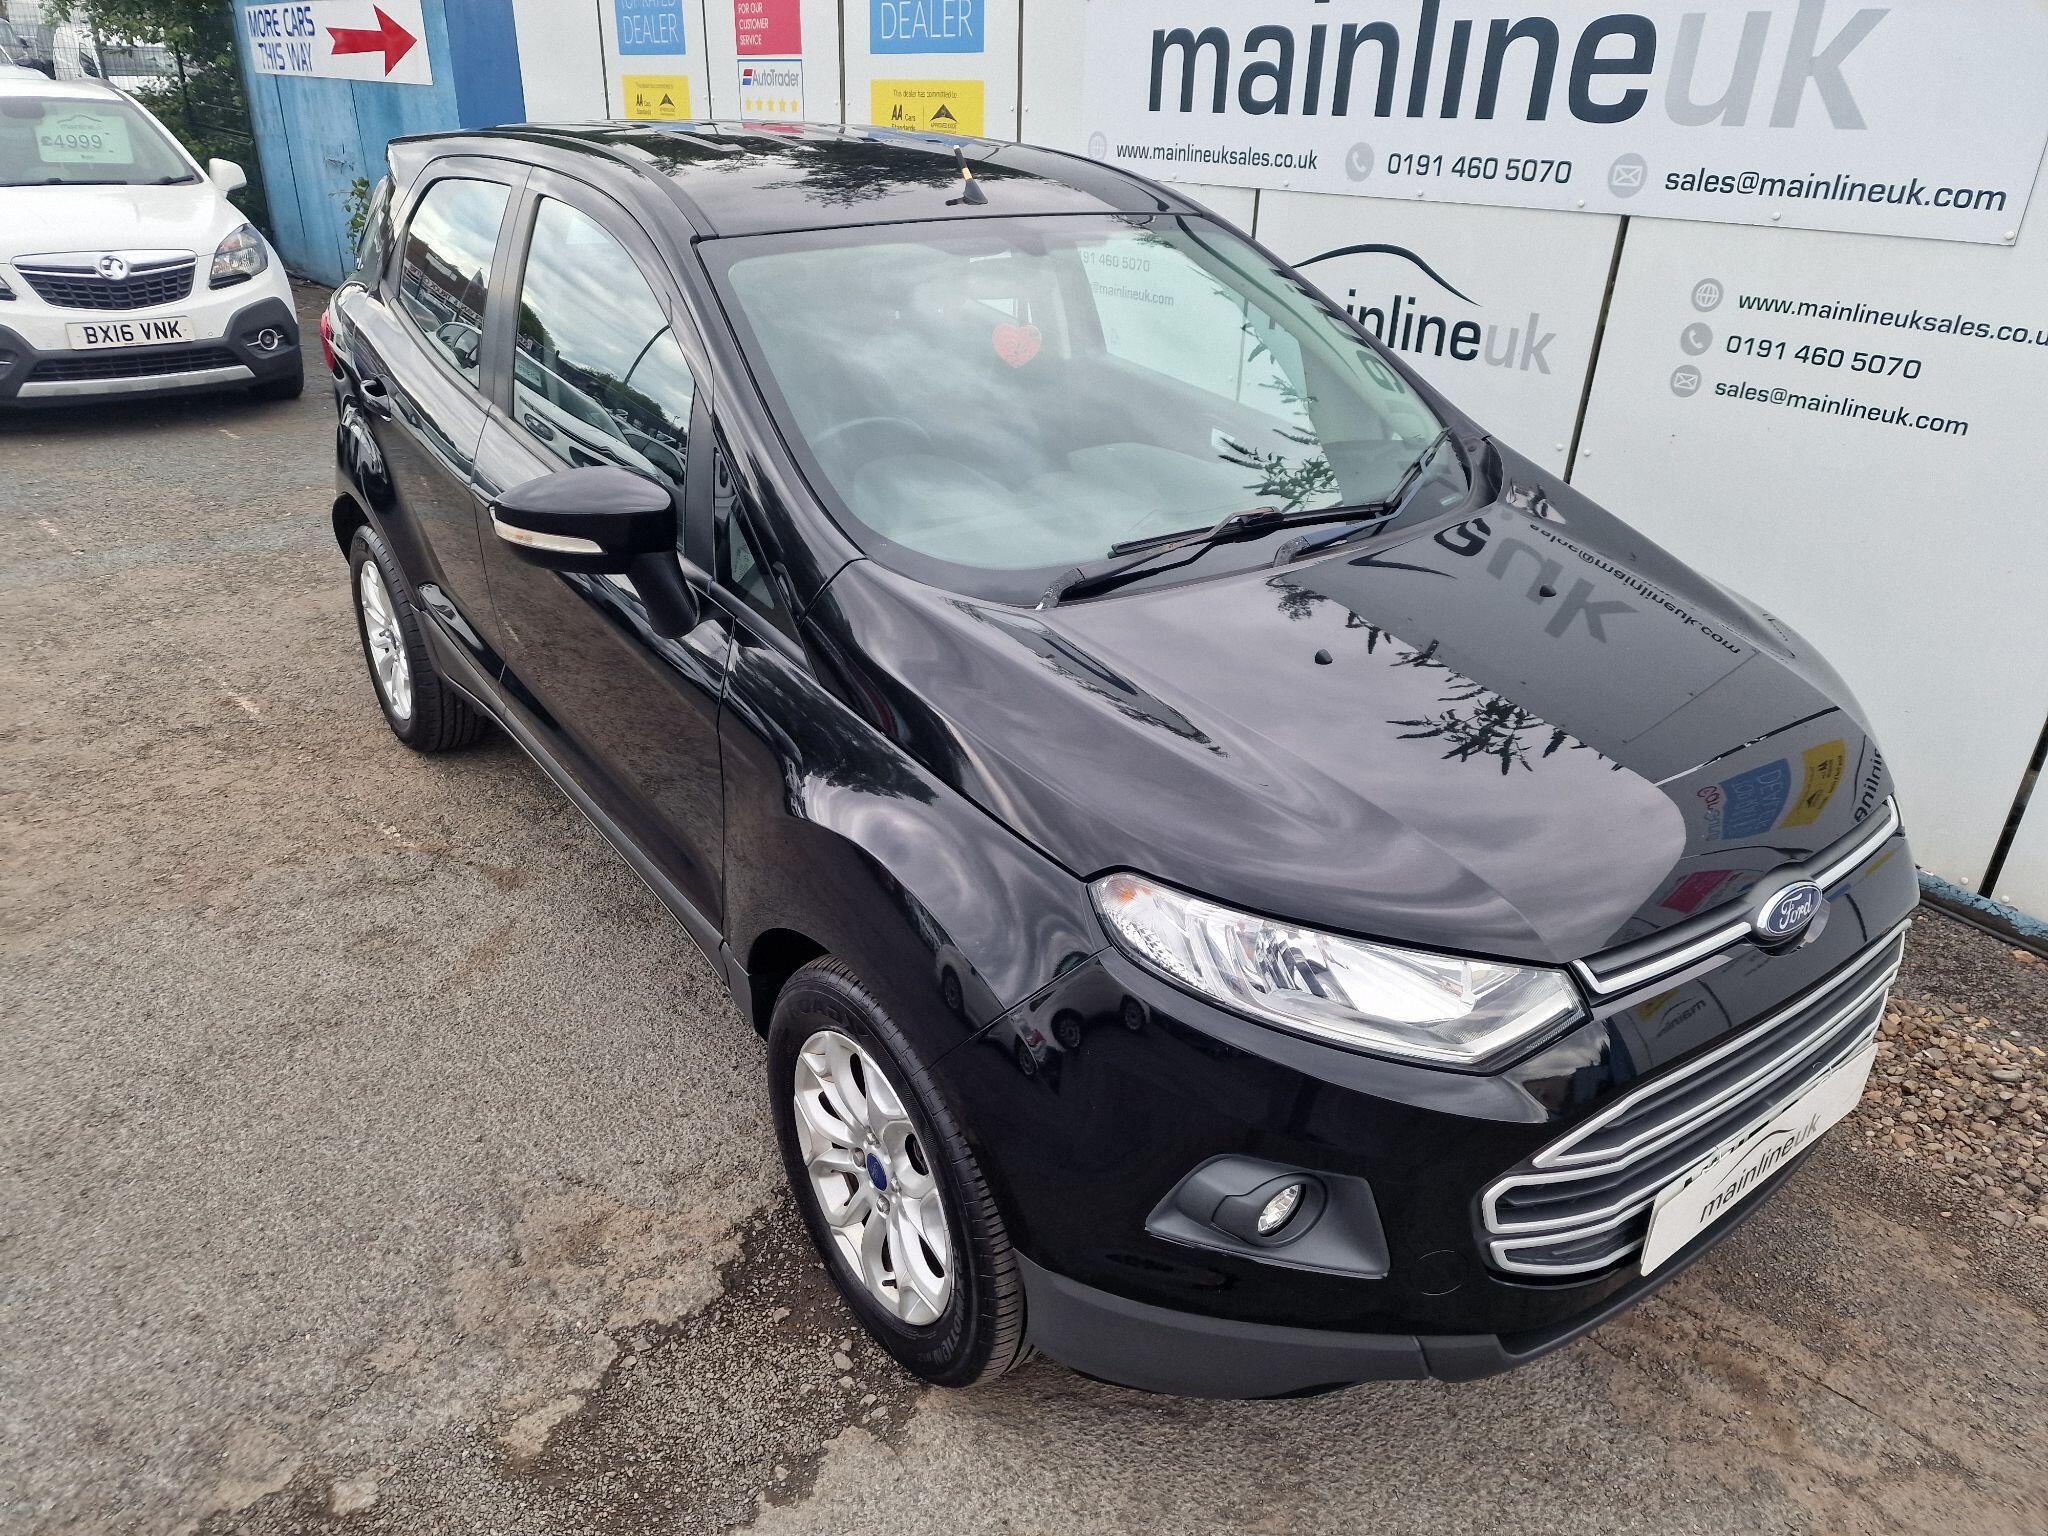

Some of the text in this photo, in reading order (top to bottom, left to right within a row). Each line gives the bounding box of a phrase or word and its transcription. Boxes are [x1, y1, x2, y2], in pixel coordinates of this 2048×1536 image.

[247, 6, 316, 37] MORE CARS
[739, 17, 769, 30] CUSTOMER
[751, 2, 763, 13] OUR
[880, 0, 973, 39] DEALER
[622, 13, 680, 45] DEALER
[740, 34, 762, 46] SERVICE
[257, 42, 313, 72] THIS WAY
[1148, 0, 1891, 132] mainlineuk
[752, 68, 800, 88] AutoTrader
[891, 103, 916, 122] AA Cars
[1116, 142, 1318, 170] www.mainlineuksales.co.uk
[1387, 152, 1573, 184] 0191 460 5070
[1664, 167, 2008, 212] sales@mainlineuk.com
[83, 320, 183, 345] BX16 VNK
[1345, 287, 1558, 376] inlineuk
[1738, 293, 2048, 348] www.mainlineuksales.co.u
[1726, 335, 1922, 380] 0191 460 5070
[1714, 380, 1970, 438] sales@mainlineuk.com
[1779, 892, 1813, 930] Ford
[1699, 1112, 1822, 1224] mainlineuk
